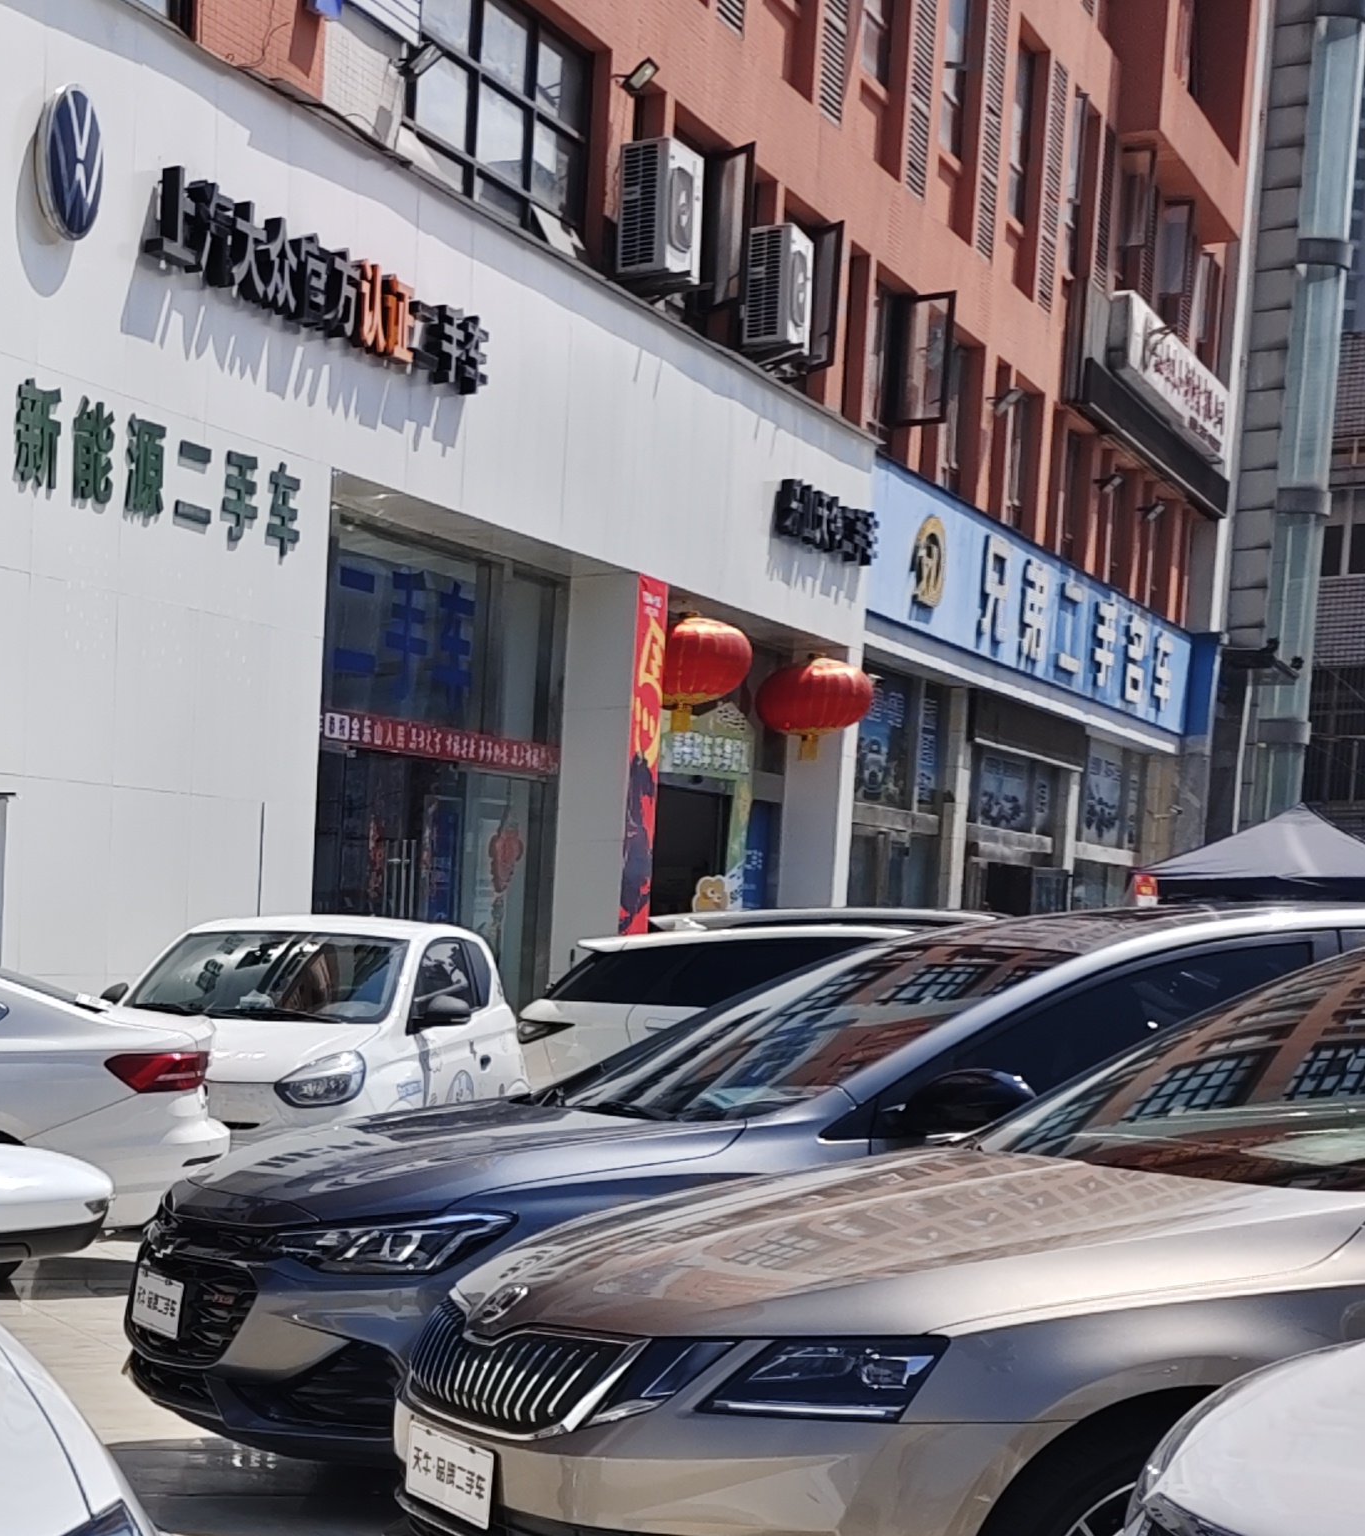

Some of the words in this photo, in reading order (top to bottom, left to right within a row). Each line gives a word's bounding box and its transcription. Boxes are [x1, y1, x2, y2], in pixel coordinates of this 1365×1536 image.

[13, 378, 301, 564] 新能源二手车
[980, 533, 1173, 714] 兄弟二手名车
